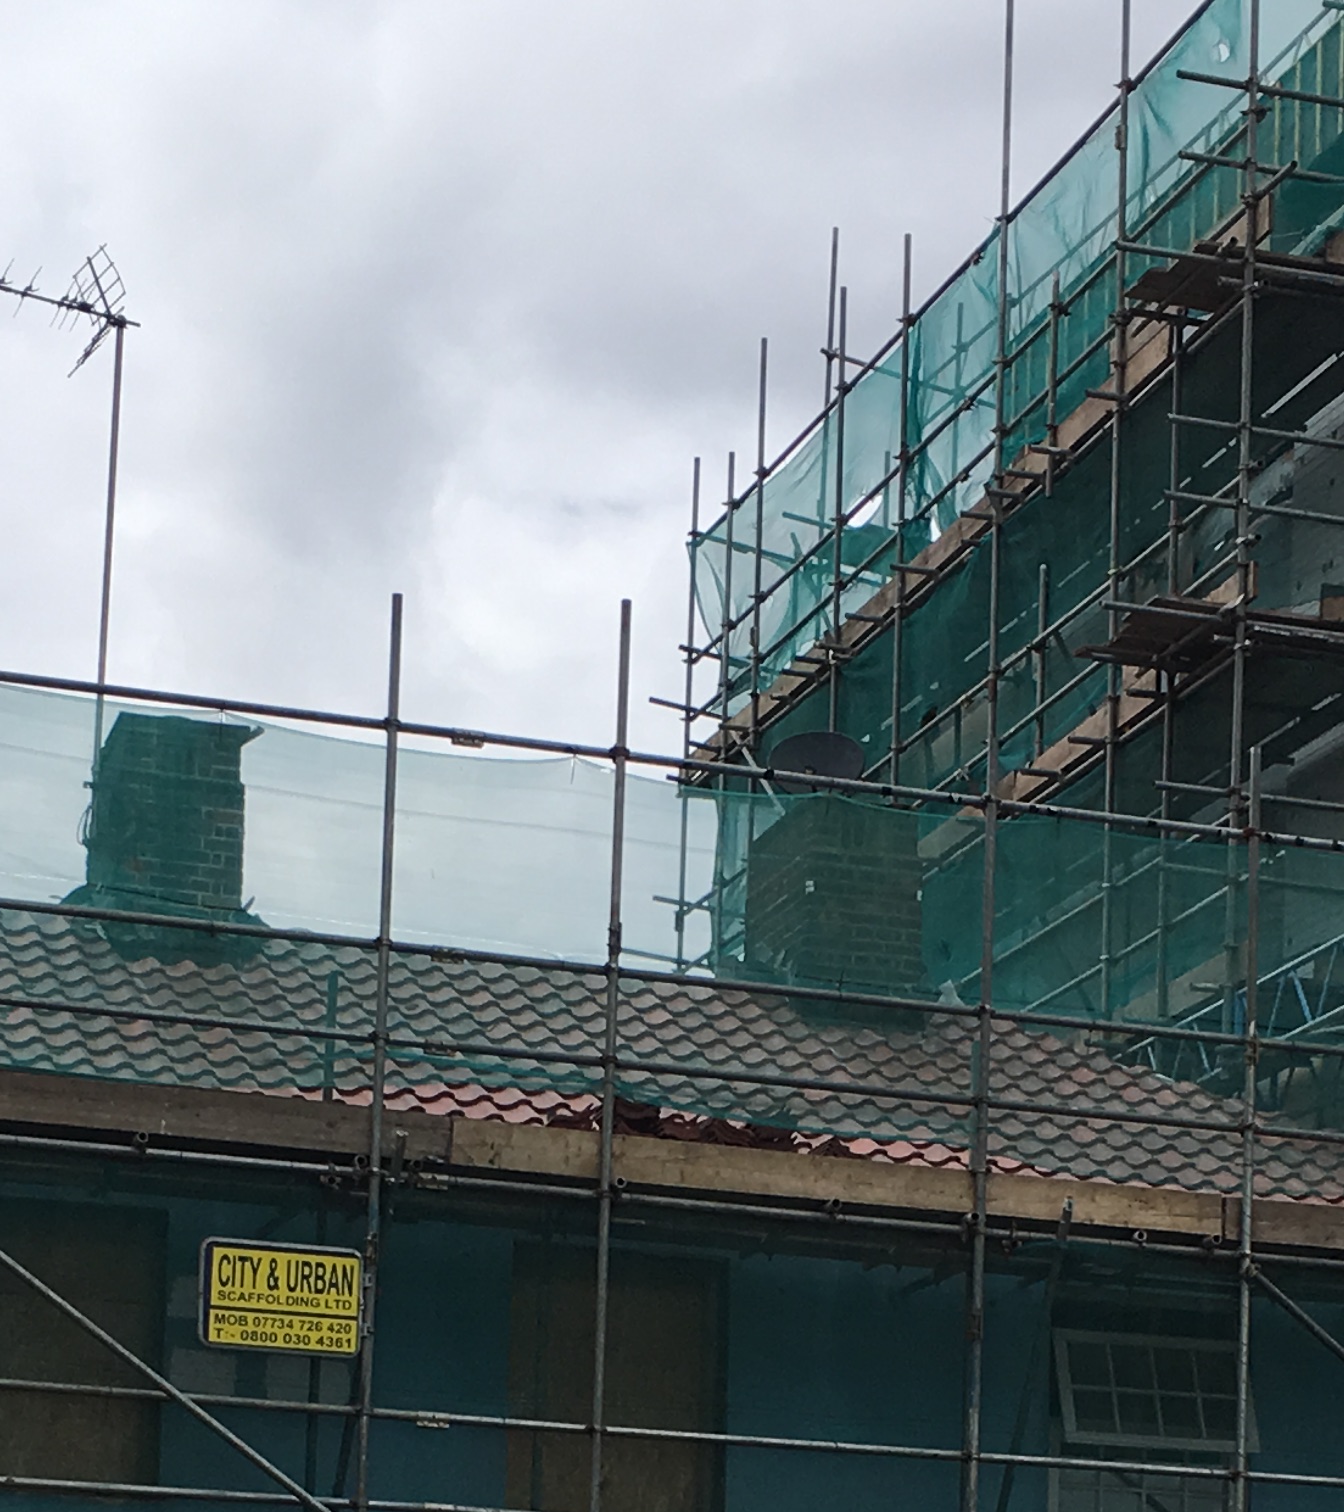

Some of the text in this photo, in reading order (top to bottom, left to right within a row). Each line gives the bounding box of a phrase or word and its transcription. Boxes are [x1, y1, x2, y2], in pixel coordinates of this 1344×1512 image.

[218, 1254, 355, 1297] CITY & URBAN
[217, 1290, 352, 1311] SCAFFOLDING LTD
[213, 1313, 352, 1335] MOB 07734 726 420
[240, 1330, 278, 1344] 0800
[283, 1333, 311, 1346] 030
[315, 1336, 352, 1348] 4361
